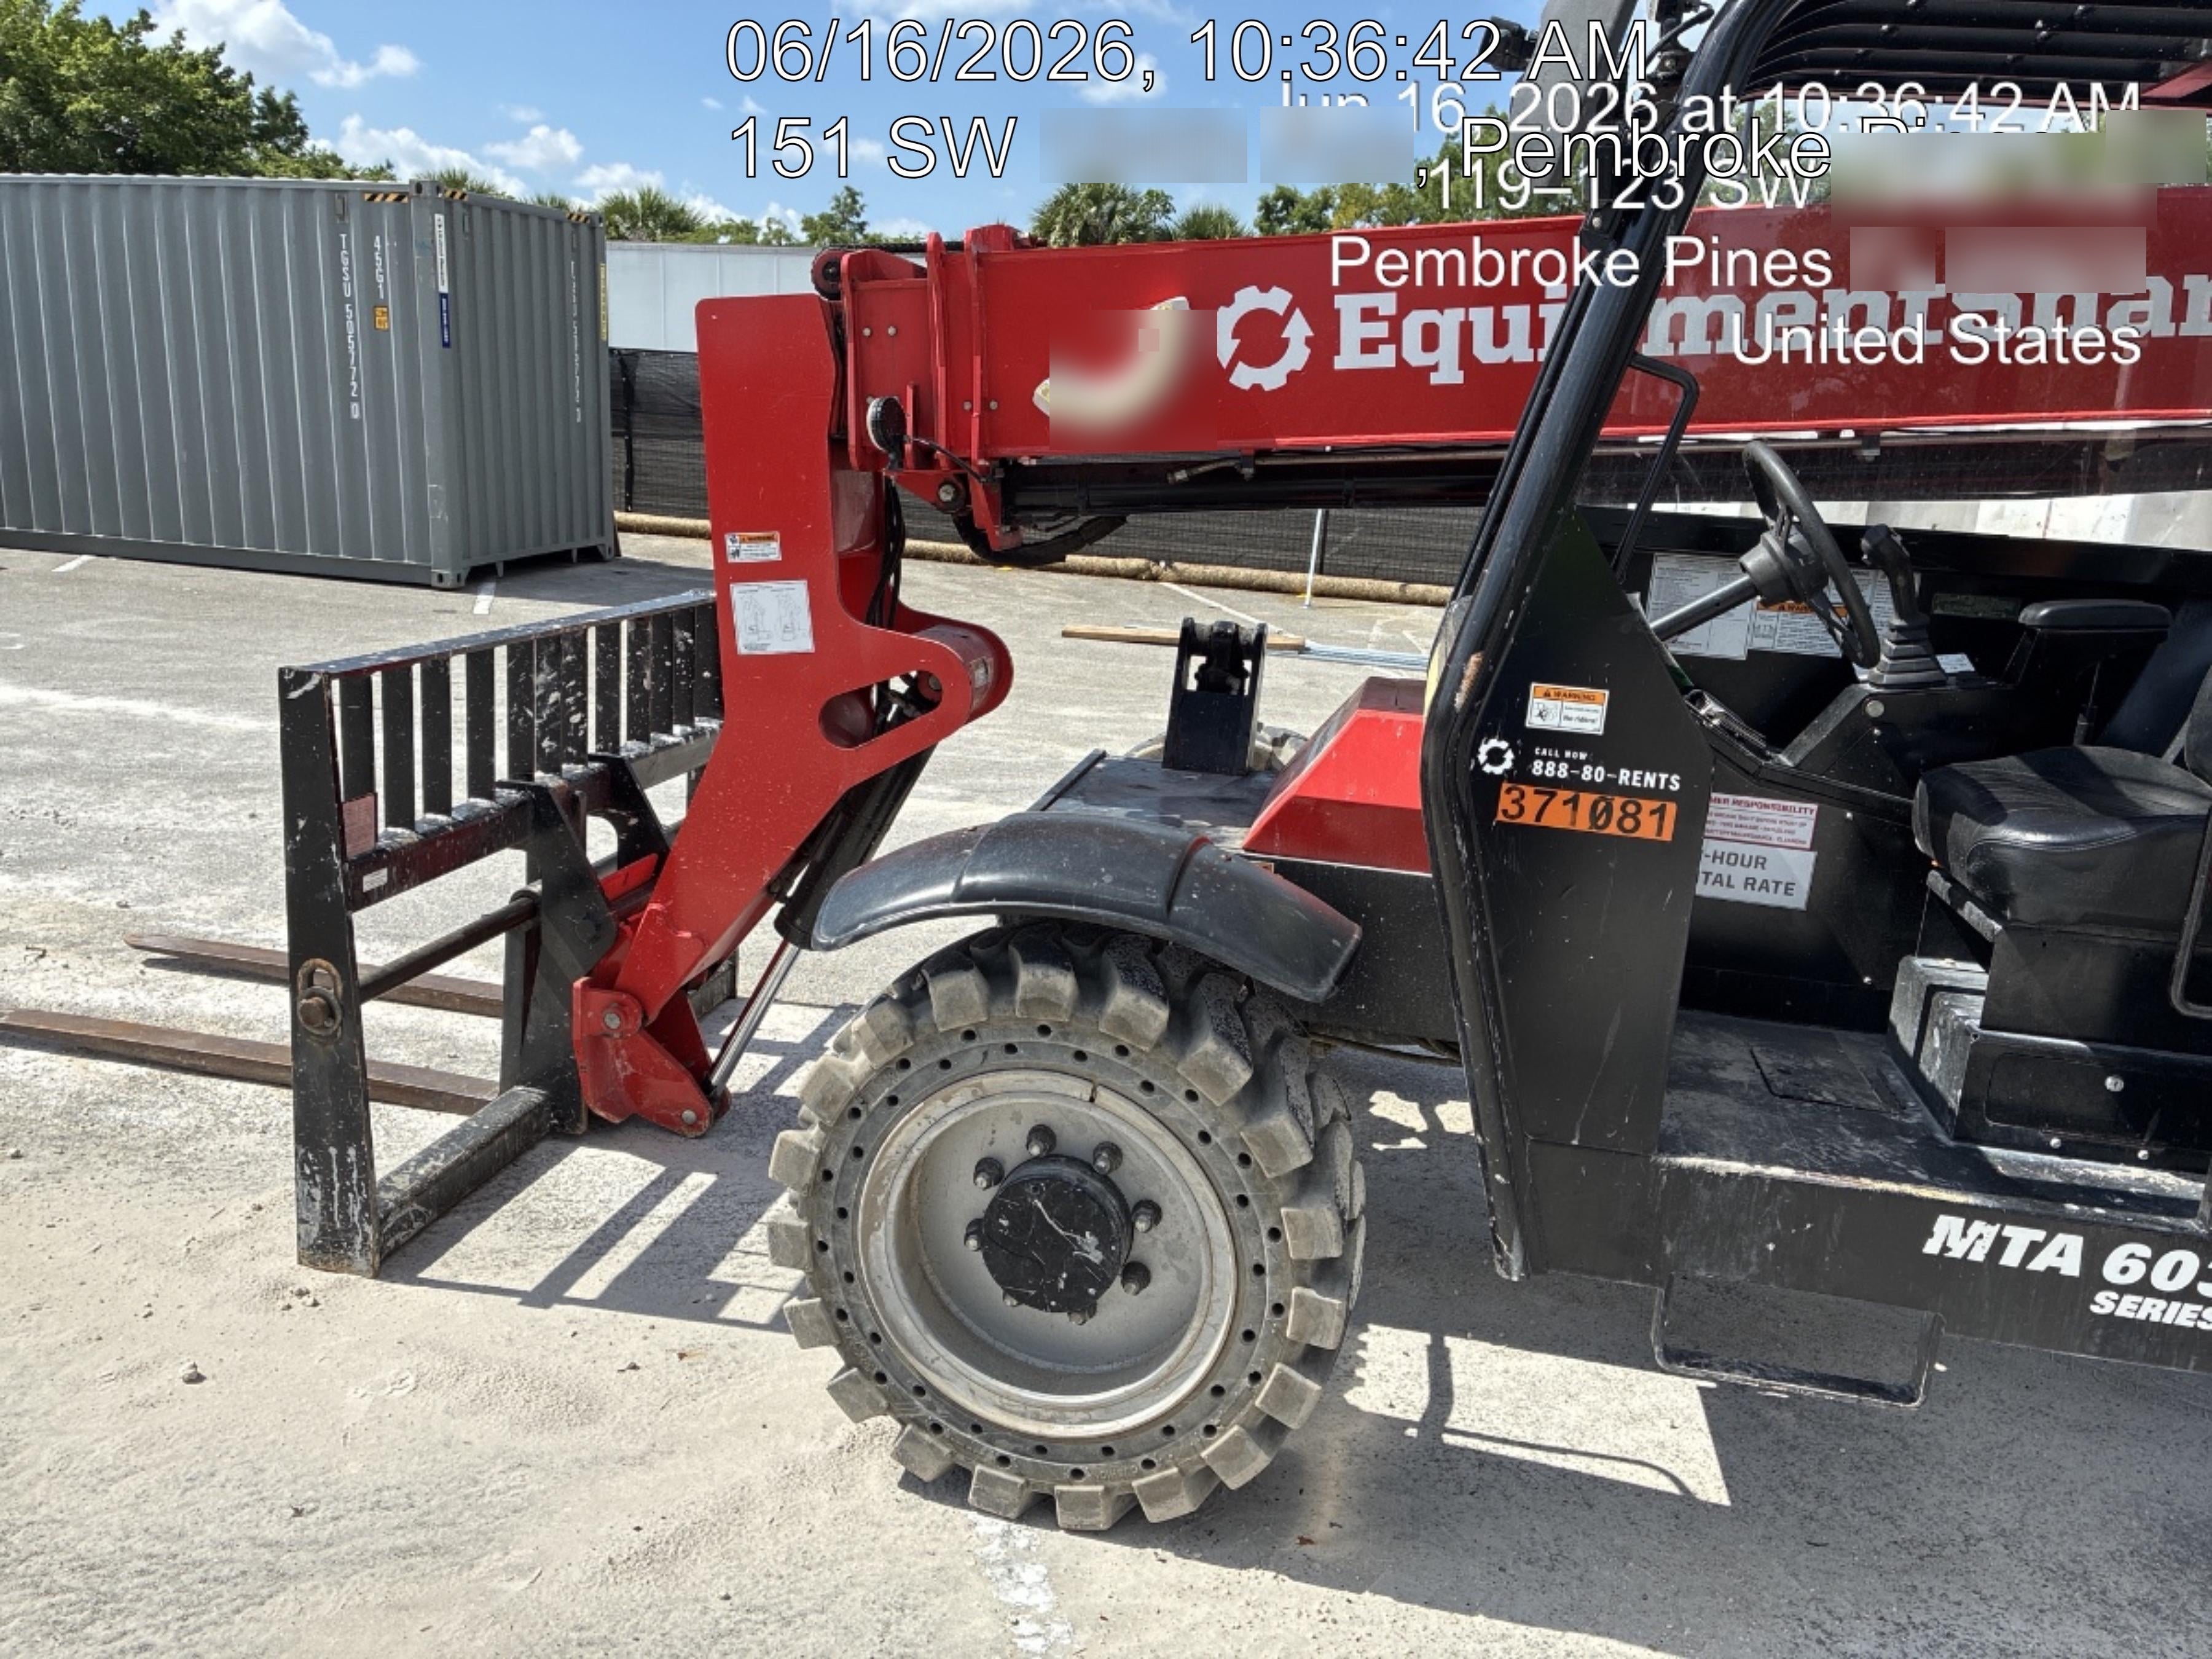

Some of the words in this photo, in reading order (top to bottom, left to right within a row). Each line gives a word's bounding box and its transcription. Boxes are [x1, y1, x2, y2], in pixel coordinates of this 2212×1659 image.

[339, 233, 351, 297] TGSU
[1535, 747, 1560, 758] CALL
[1531, 759, 1681, 791] 888-80-RENTS
[1501, 786, 1668, 837] 371081
[1743, 876, 1796, 896] RATE
[1922, 1214, 2084, 1277] MTA
